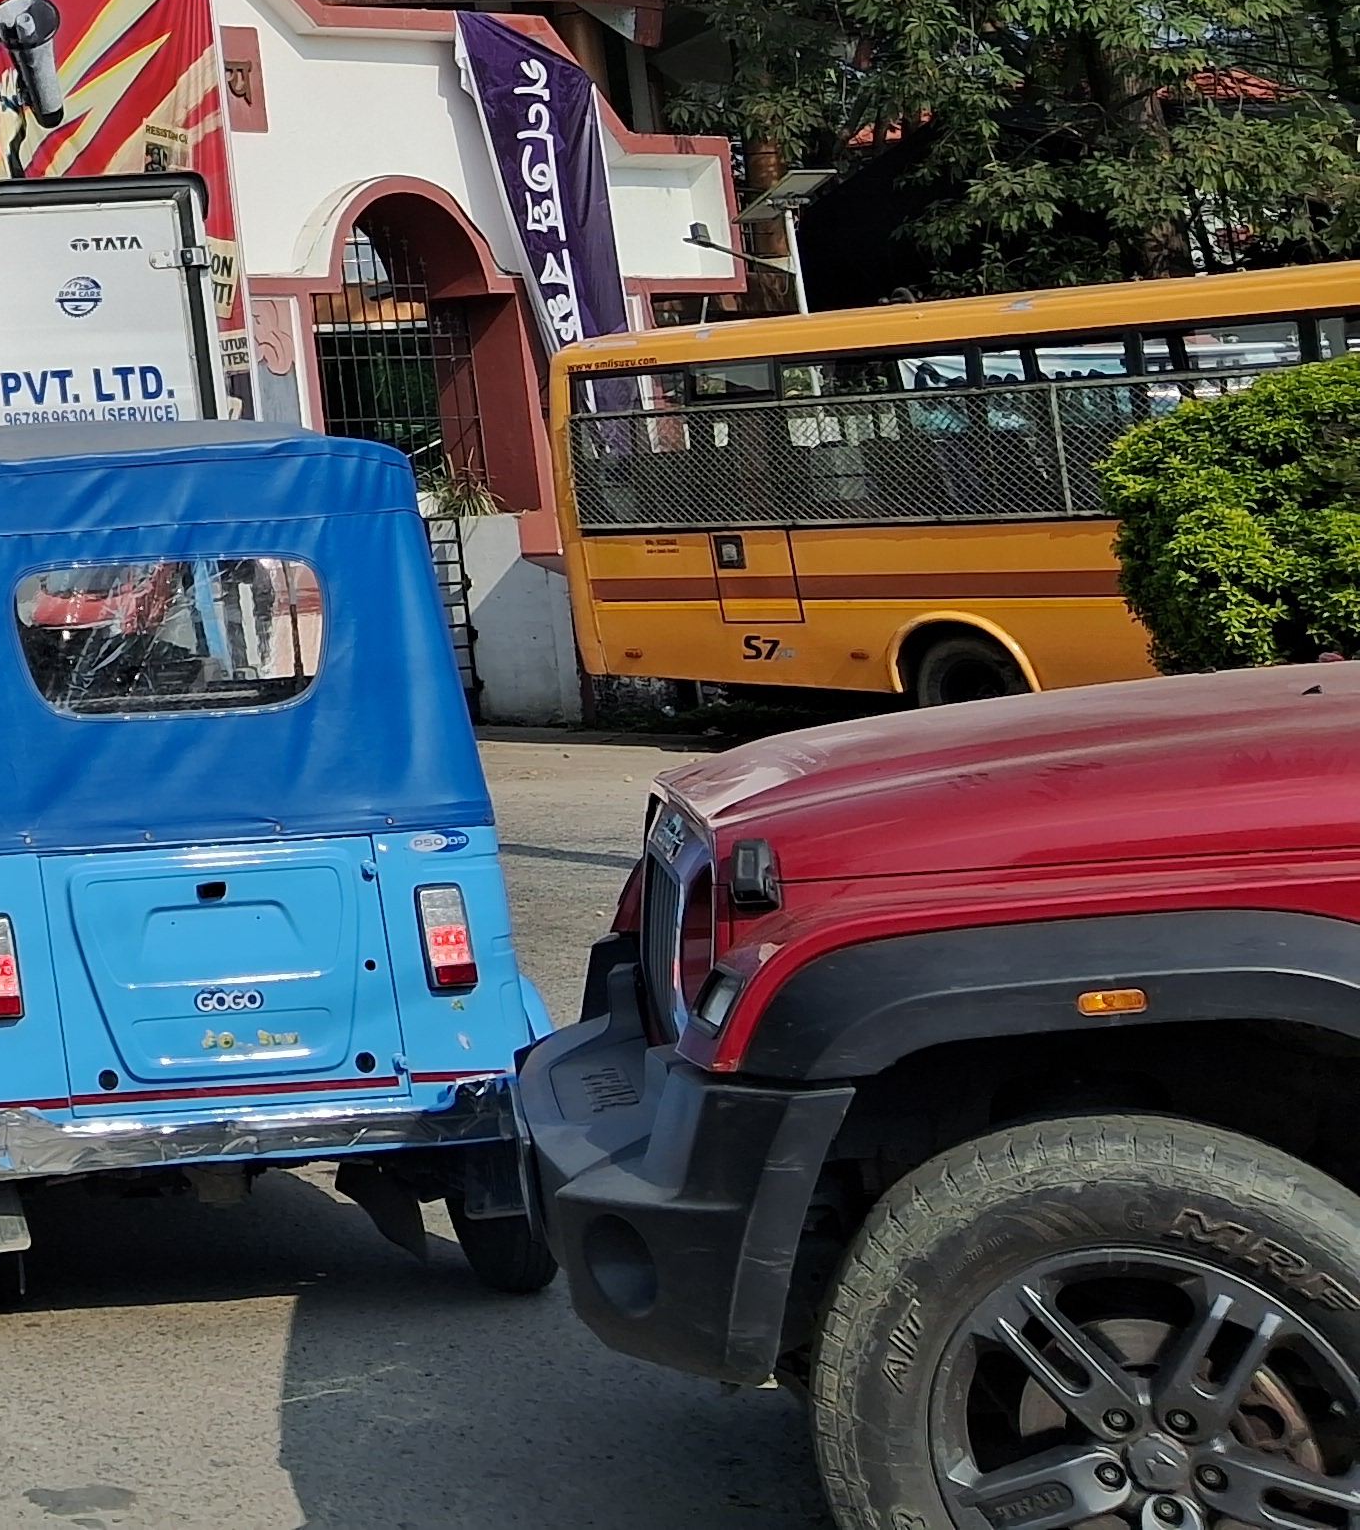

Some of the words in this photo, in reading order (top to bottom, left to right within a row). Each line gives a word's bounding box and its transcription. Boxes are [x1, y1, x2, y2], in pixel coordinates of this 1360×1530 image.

[91, 236, 143, 251] TATA
[0, 369, 81, 407] PVT.
[92, 365, 176, 403] LTD.
[101, 402, 180, 422] (SERVICE)
[742, 635, 781, 661] S7
[196, 989, 263, 1012] GOGO
